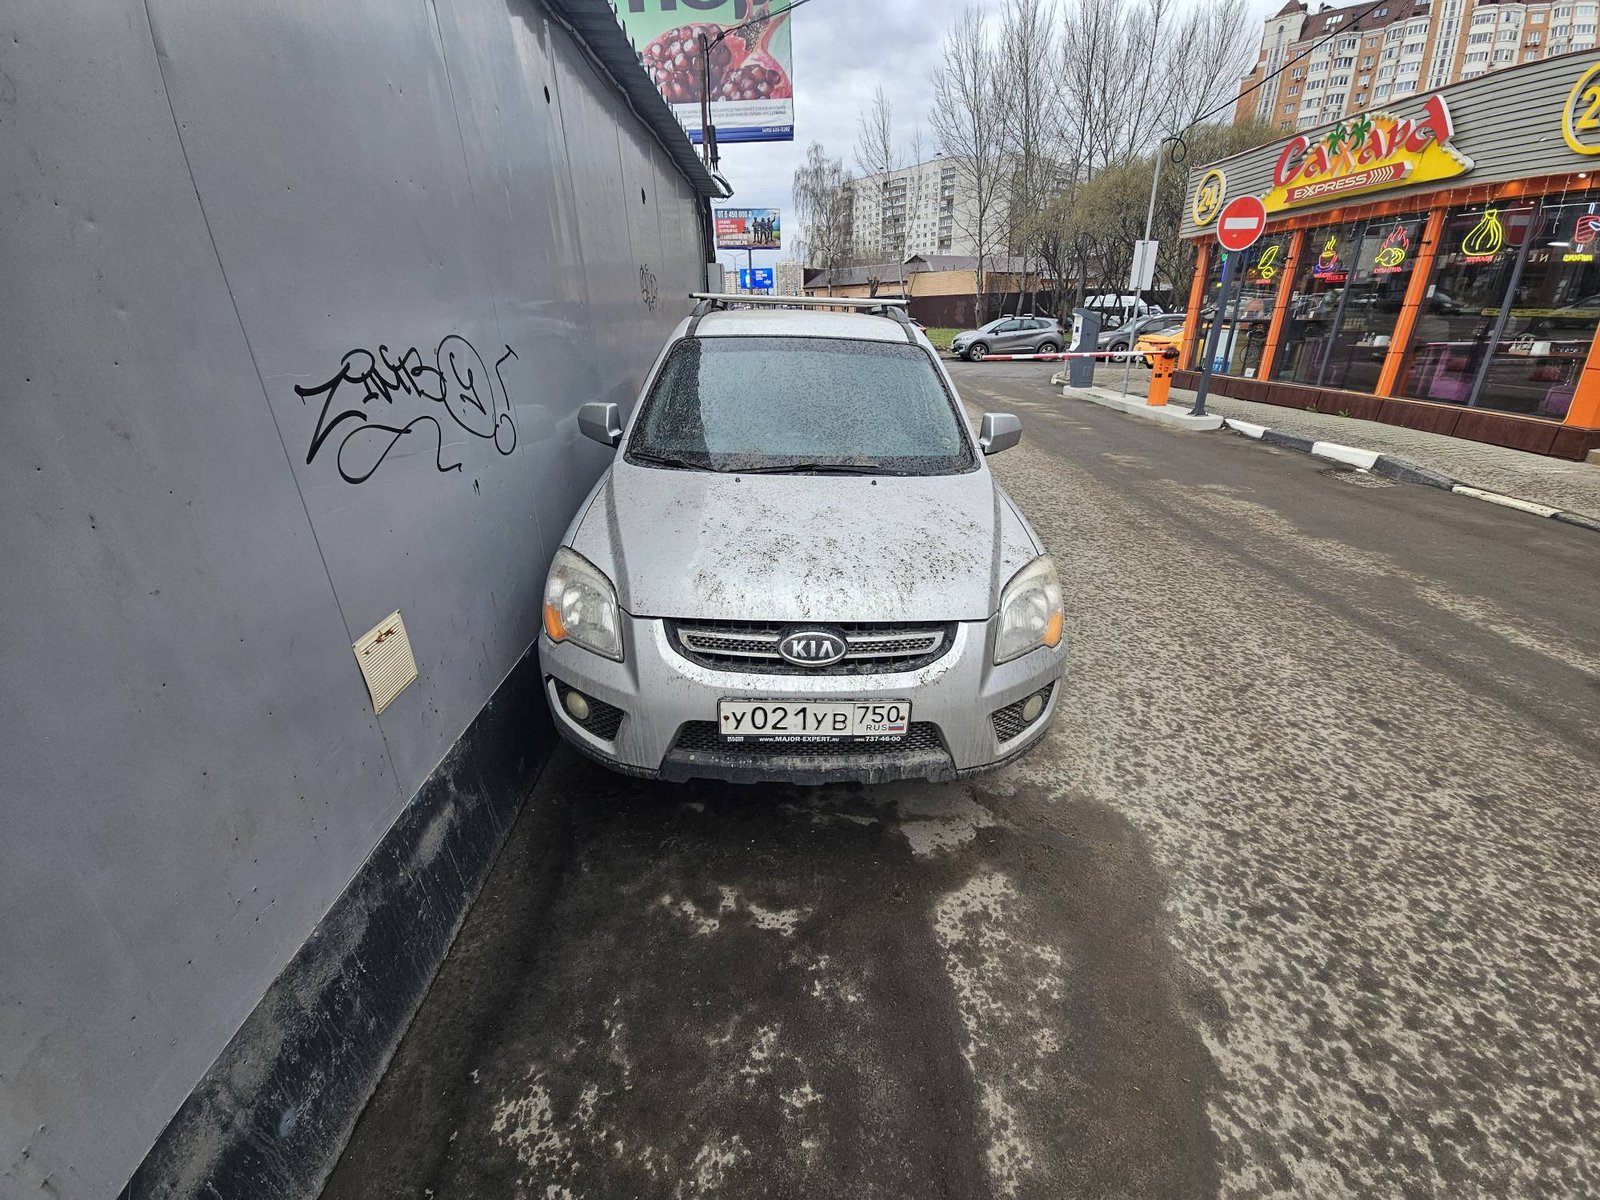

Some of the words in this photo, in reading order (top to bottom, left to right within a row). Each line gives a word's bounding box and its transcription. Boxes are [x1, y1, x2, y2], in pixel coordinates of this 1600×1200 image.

[1293, 173, 1368, 200] EXPRESS
[791, 640, 836, 658] KIA
[856, 705, 900, 724] 750
[865, 723, 888, 732] RUS
